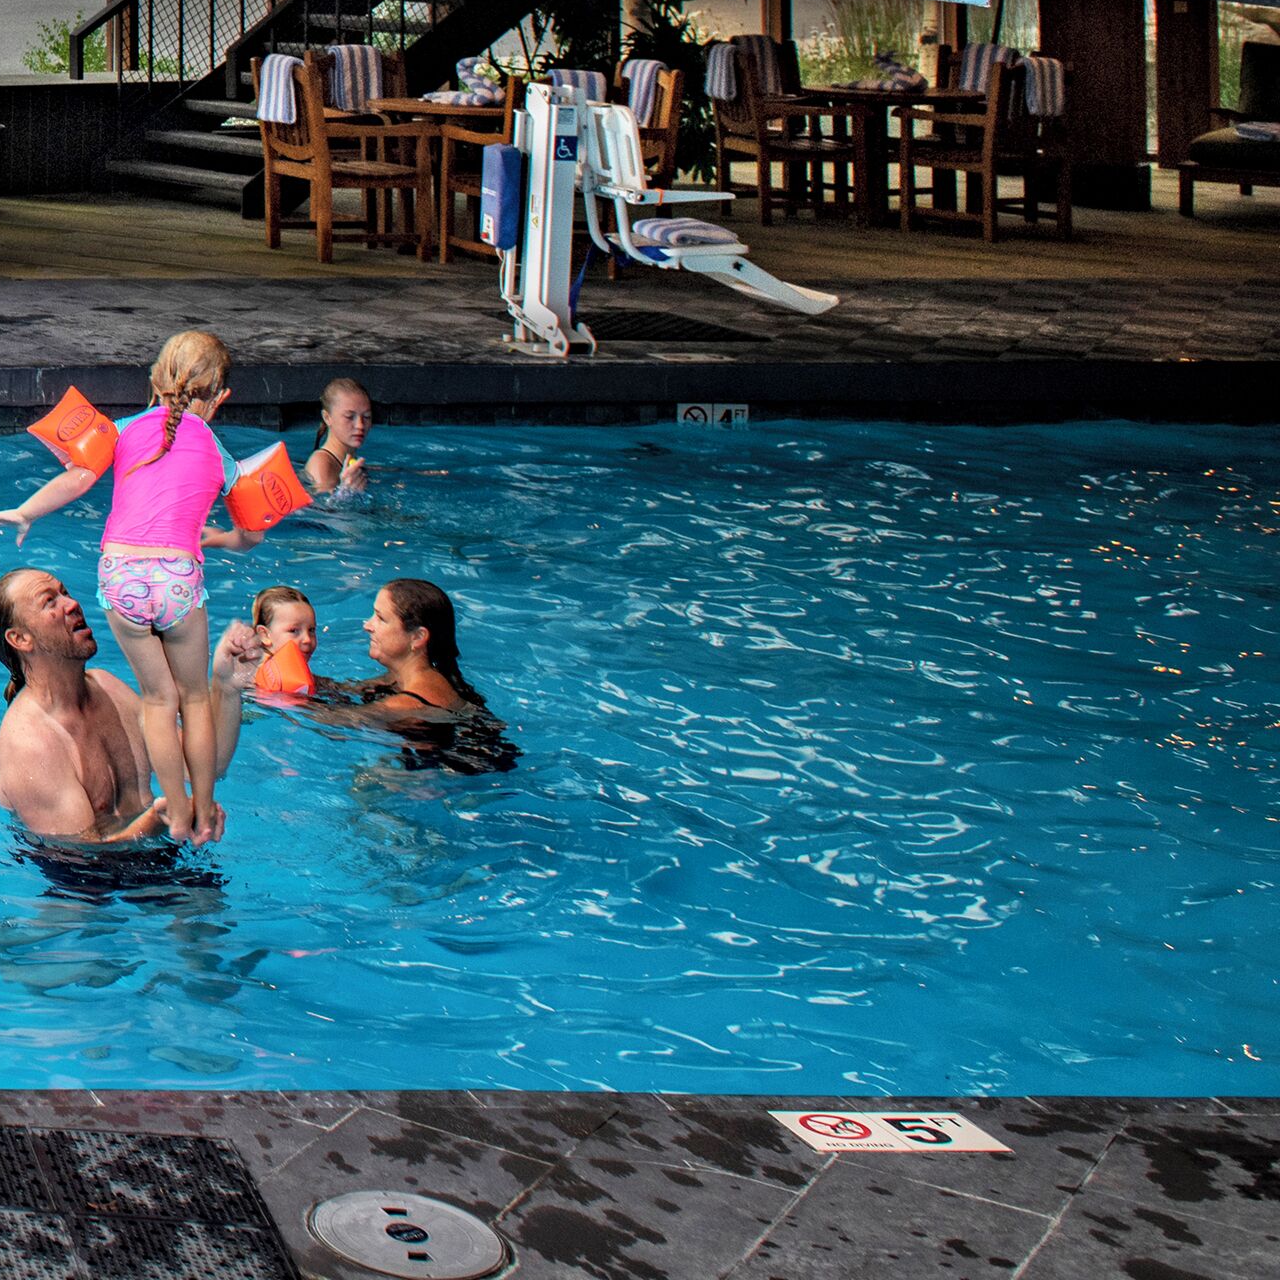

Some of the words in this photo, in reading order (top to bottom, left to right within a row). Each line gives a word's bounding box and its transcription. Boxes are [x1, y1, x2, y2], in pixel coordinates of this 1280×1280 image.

[61, 407, 91, 437] INTEX
[720, 409, 732, 423] 4
[734, 409, 746, 419] FT
[881, 1118, 953, 1145] 5
[929, 1117, 963, 1128] FT
